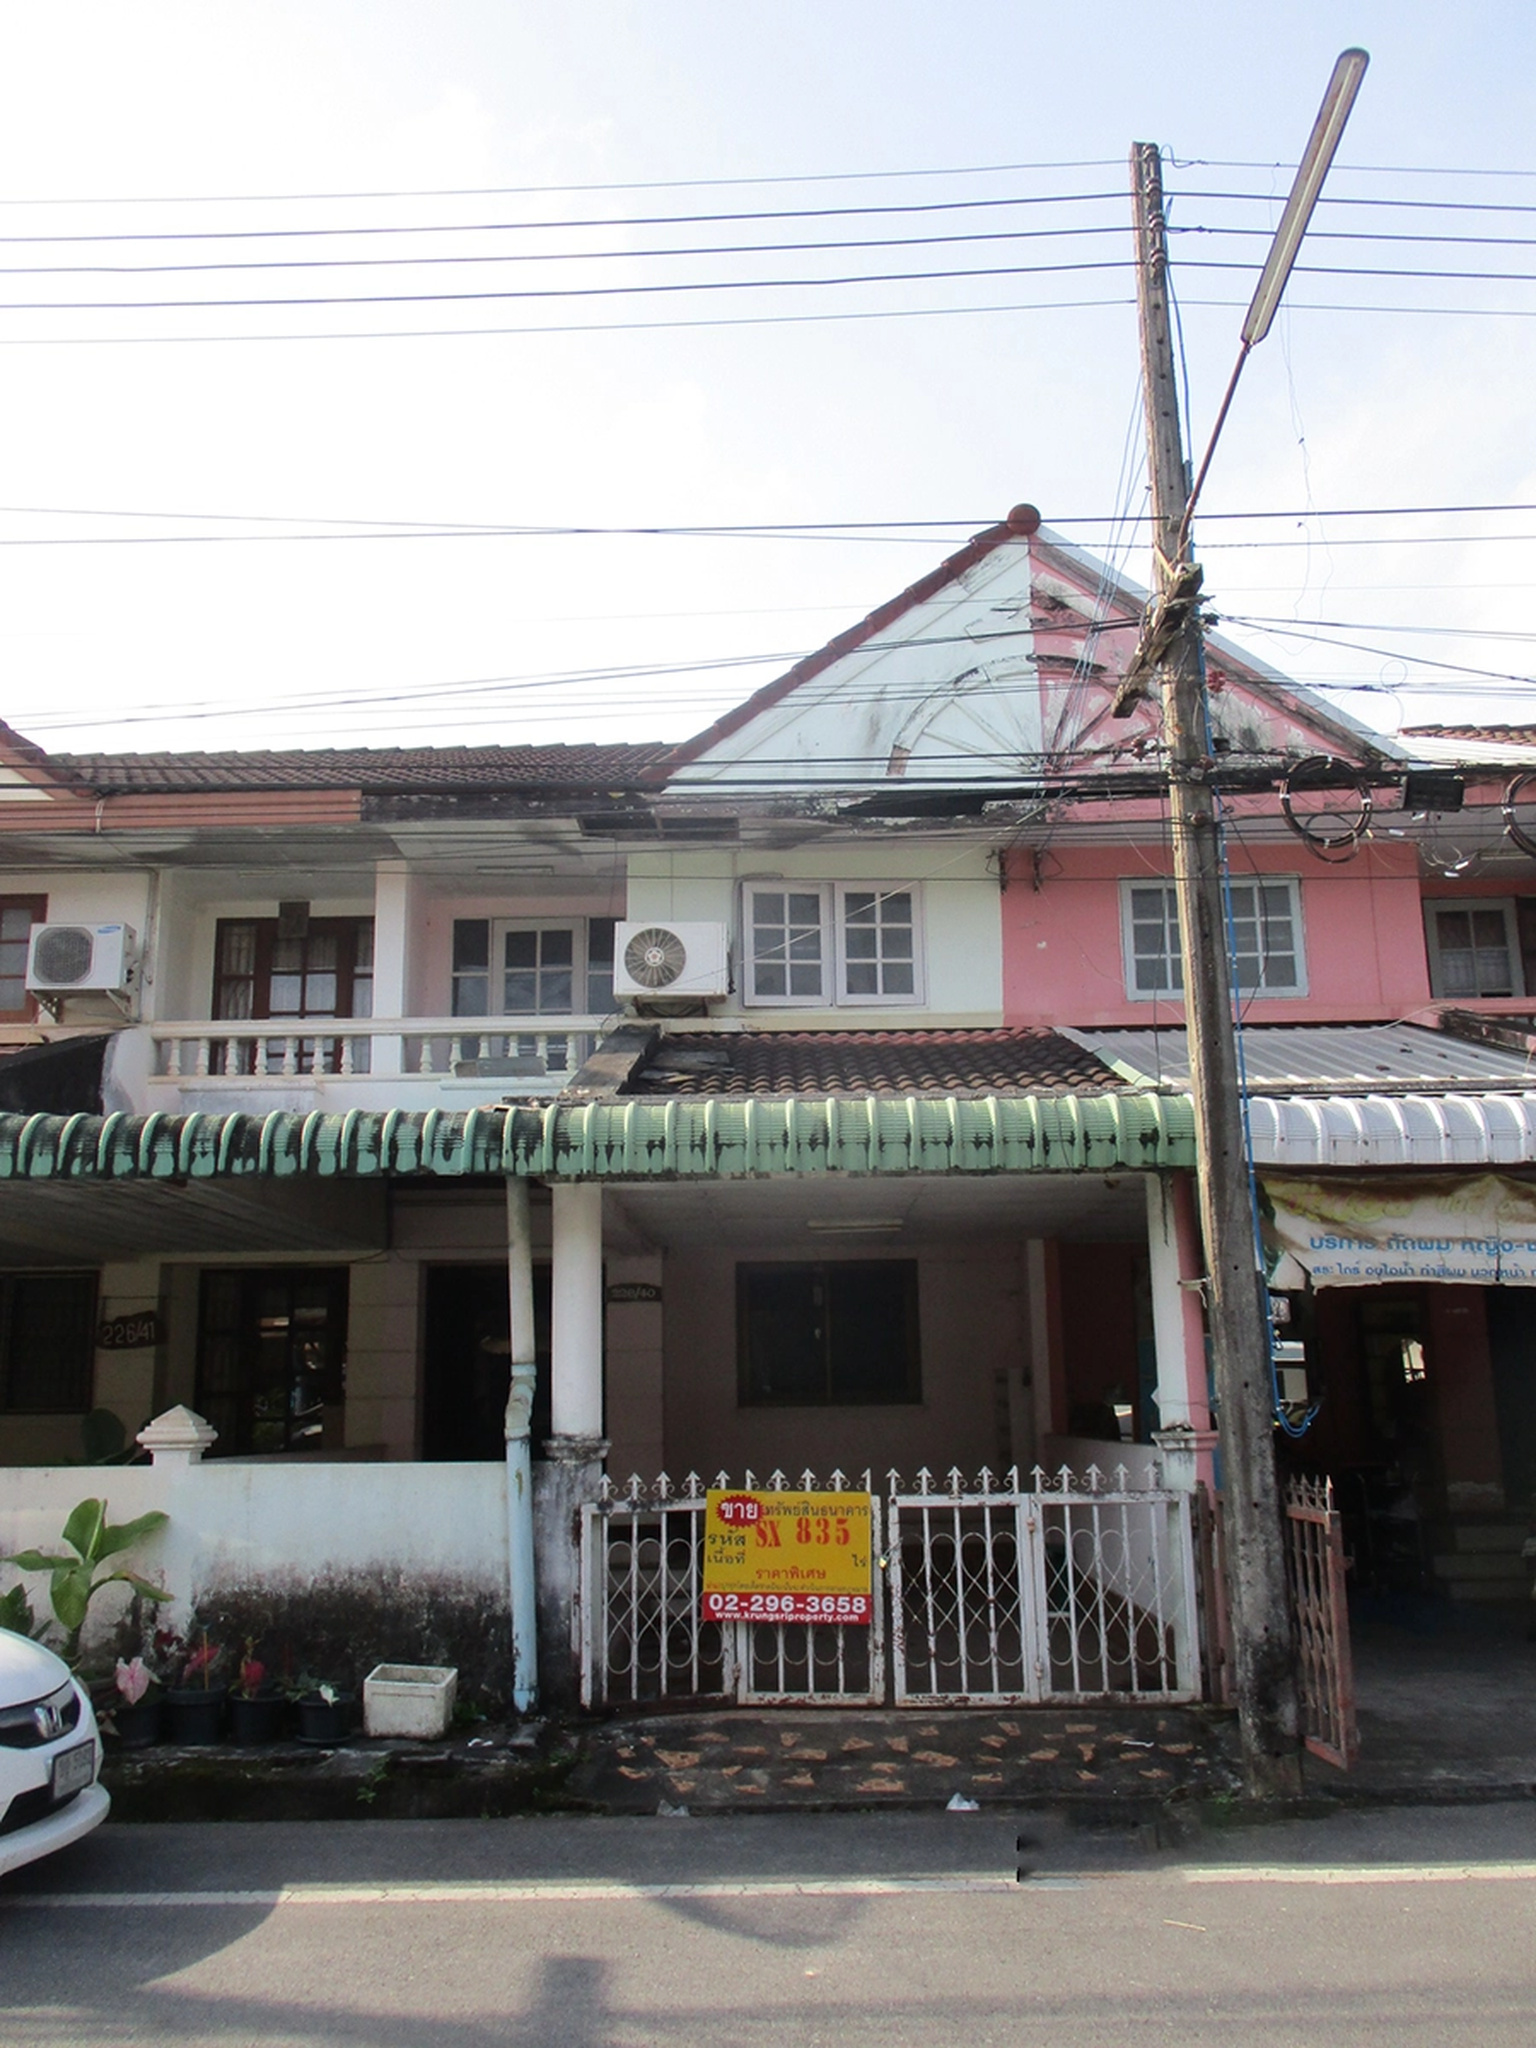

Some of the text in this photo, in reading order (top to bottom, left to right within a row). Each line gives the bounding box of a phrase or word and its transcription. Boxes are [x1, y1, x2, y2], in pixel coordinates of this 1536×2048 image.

[103, 1321, 155, 1345] 226/41
[720, 1501, 869, 1519] ขาย ทรัพย์สินธนาคาร
[708, 1527, 746, 1545] รหัส
[755, 1517, 850, 1547] SX 835
[707, 1547, 867, 1567] เนื้อที่ ไร่
[755, 1565, 827, 1579] ราคาพิเศษ
[709, 1594, 866, 1613] 02-296-3658
[715, 1610, 859, 1622] www.krungsriproperty.com
